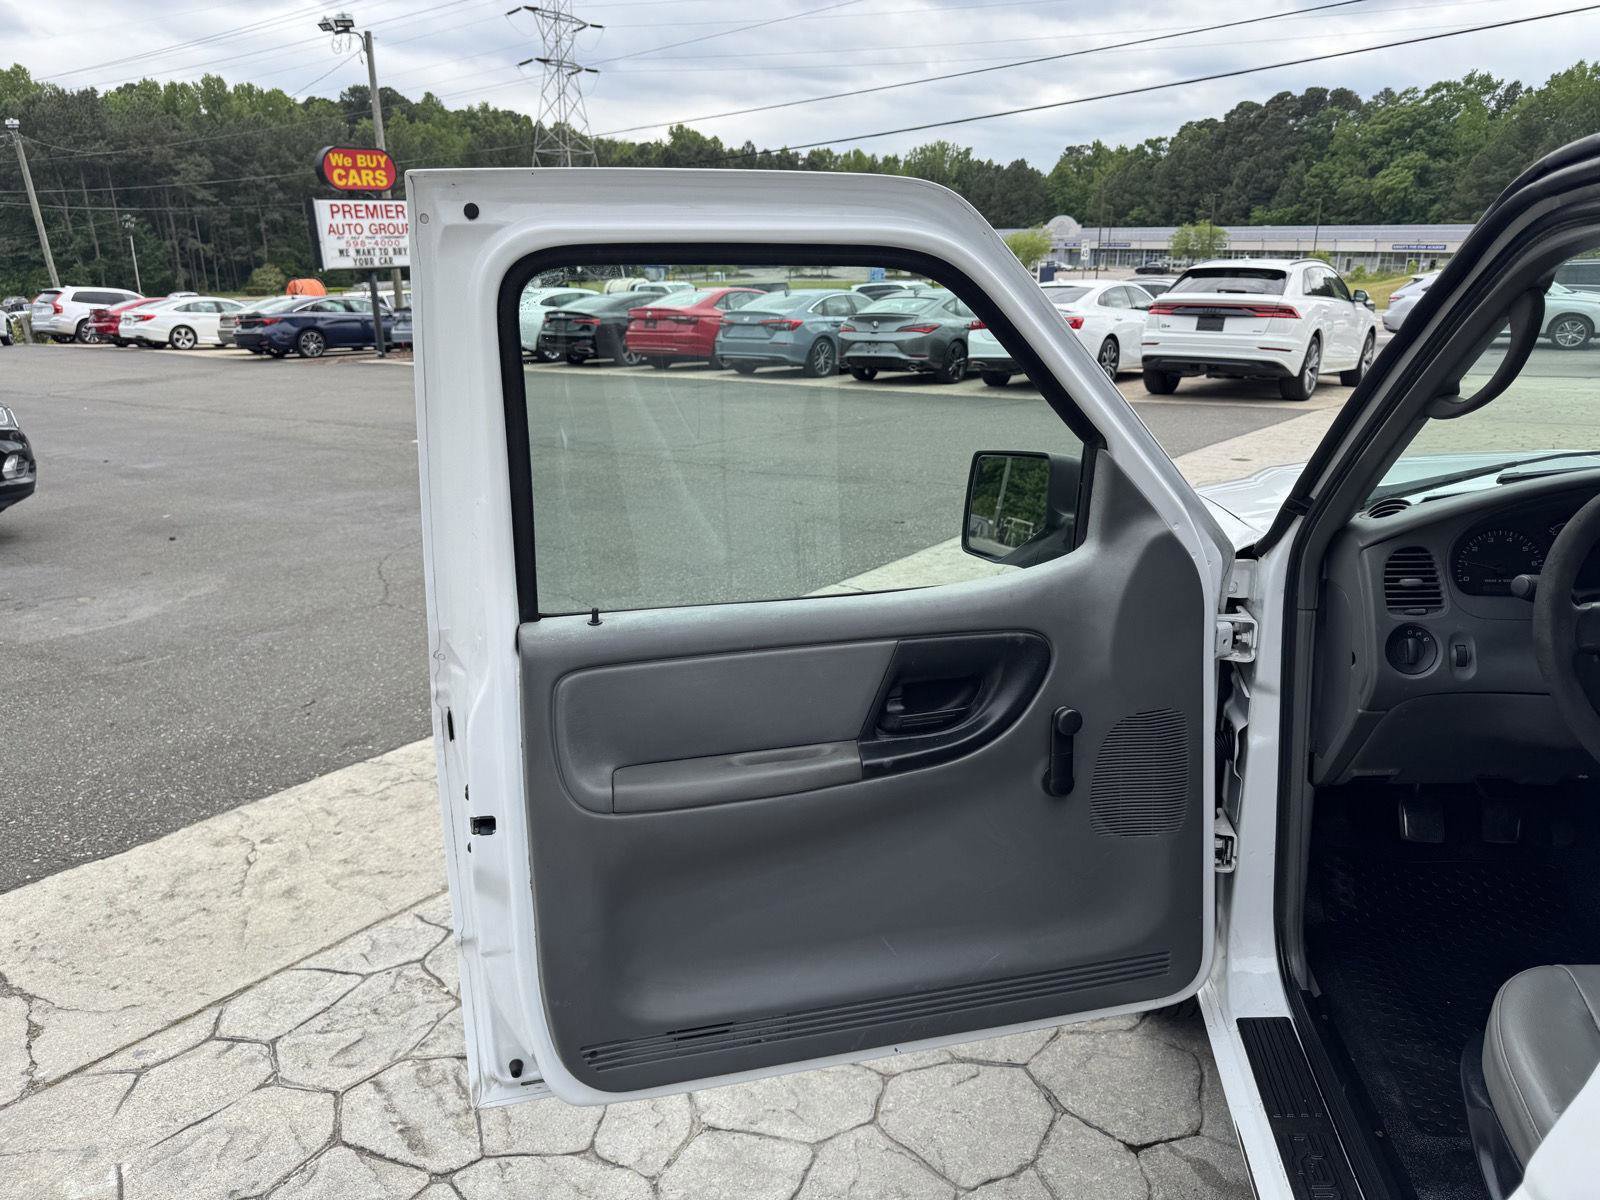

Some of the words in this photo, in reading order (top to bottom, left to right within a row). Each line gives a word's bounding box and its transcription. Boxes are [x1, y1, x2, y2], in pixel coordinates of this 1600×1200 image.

[328, 152, 353, 167] We
[356, 154, 388, 168] BUY
[332, 168, 388, 187] CARS
[329, 203, 407, 219] PREMIER
[328, 223, 364, 236] AUTO
[338, 248, 350, 257] WE
[355, 248, 376, 257] WANT
[380, 247, 389, 256] TO
[393, 247, 408, 256] BUY
[353, 257, 375, 266] YOUR
[378, 256, 394, 265] CAR
